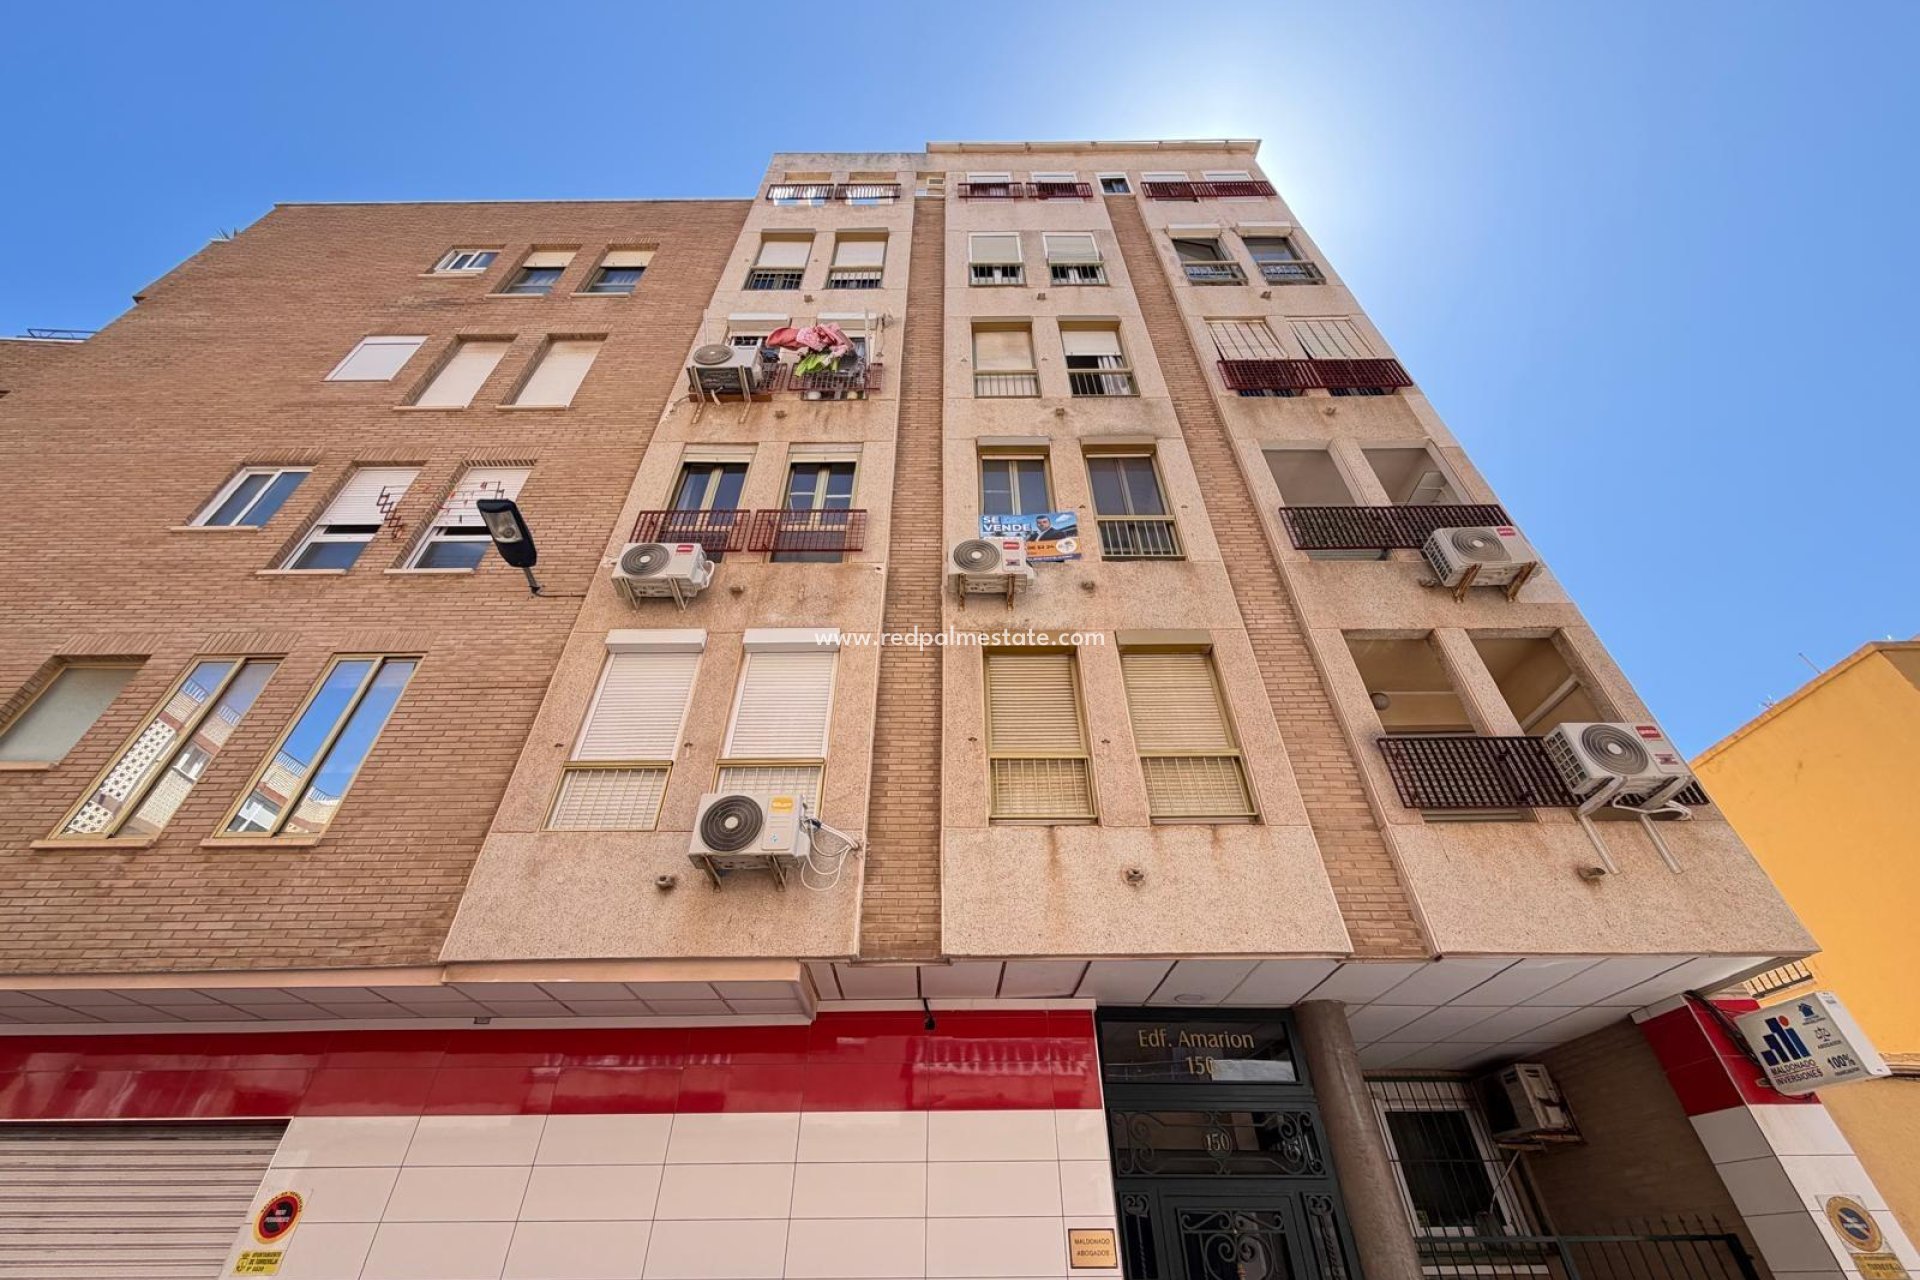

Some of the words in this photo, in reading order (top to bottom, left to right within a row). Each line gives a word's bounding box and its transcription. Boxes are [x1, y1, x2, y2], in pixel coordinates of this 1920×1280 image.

[983, 515, 1000, 524] SE
[983, 524, 1031, 532] VENDE
[1138, 1029, 1172, 1047] Edf.
[1178, 1030, 1255, 1048] Amarion
[1185, 1056, 1215, 1075] 150
[1770, 1058, 1816, 1076] MALDONADO
[1827, 1053, 1856, 1069] 100%
[1775, 1069, 1824, 1086] INVERSIONES
[1205, 1133, 1230, 1151] 150
